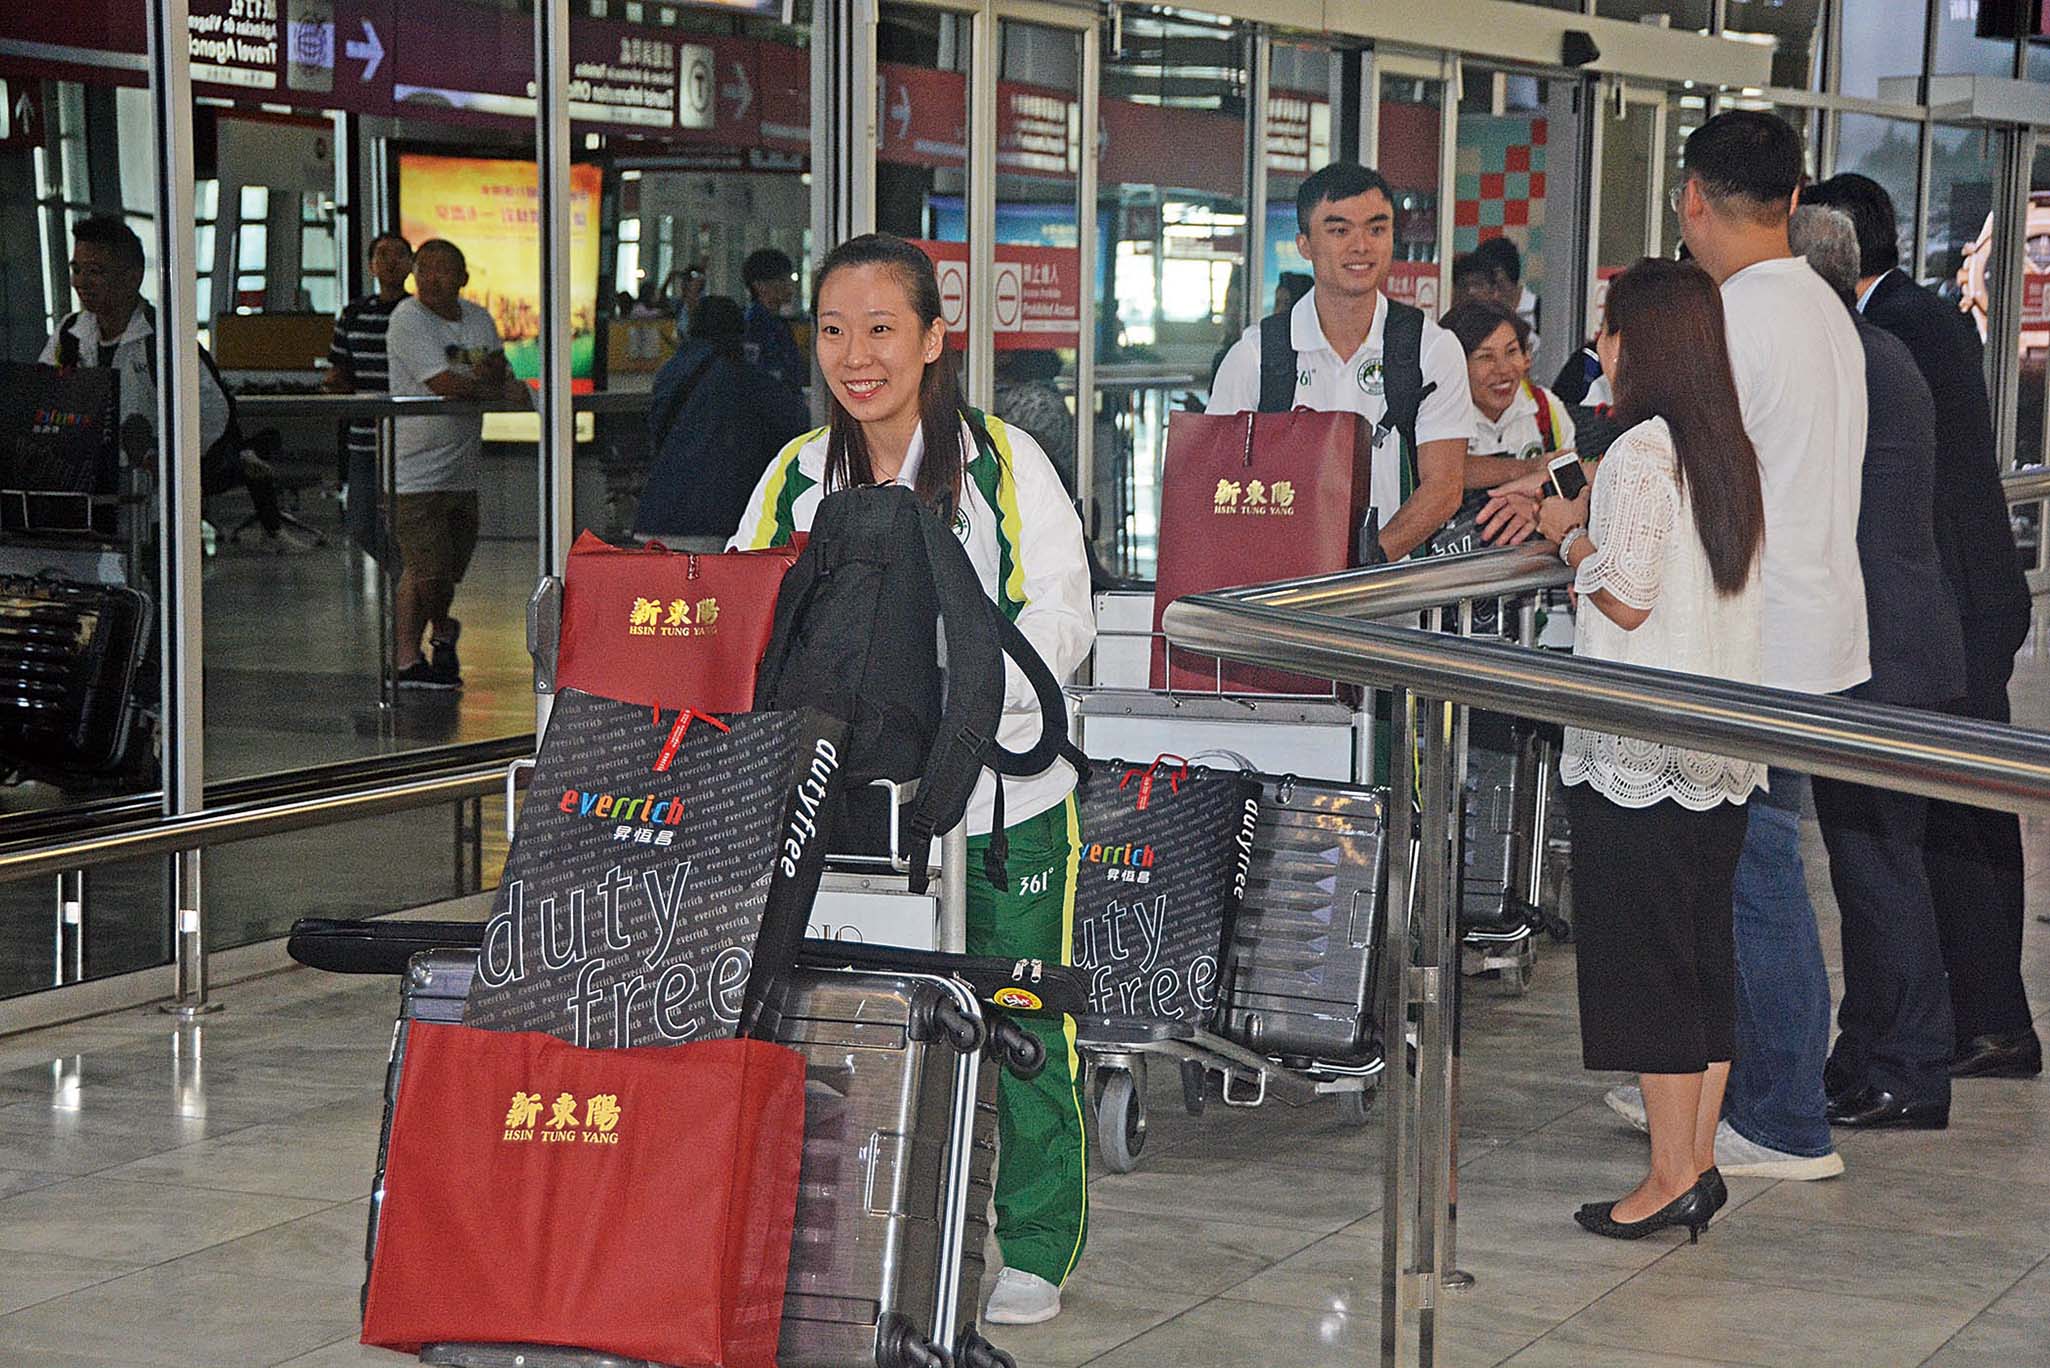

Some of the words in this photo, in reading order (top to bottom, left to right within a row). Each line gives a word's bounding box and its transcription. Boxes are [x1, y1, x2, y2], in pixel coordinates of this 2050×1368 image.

[1298, 369, 1317, 387] 61°
[1214, 478, 1296, 507] 新東陽
[1214, 505, 1236, 515] HSIN
[1241, 506, 1266, 515] TUNG
[1270, 506, 1294, 516] YANG
[629, 597, 721, 627] 新東陽
[629, 625, 656, 636] HSIN
[660, 626, 690, 637] TUNG
[560, 788, 685, 826] everrich
[781, 737, 839, 878] dutyfree
[1081, 842, 1155, 869] verrich
[478, 861, 691, 988] duty
[1072, 894, 1167, 973] uty
[568, 947, 752, 1049] free
[1089, 955, 1218, 1020] free
[505, 1091, 622, 1131] 新東陽
[503, 1129, 534, 1141] HSIN
[541, 1130, 576, 1142] TUNG
[582, 1131, 619, 1144] YANG
